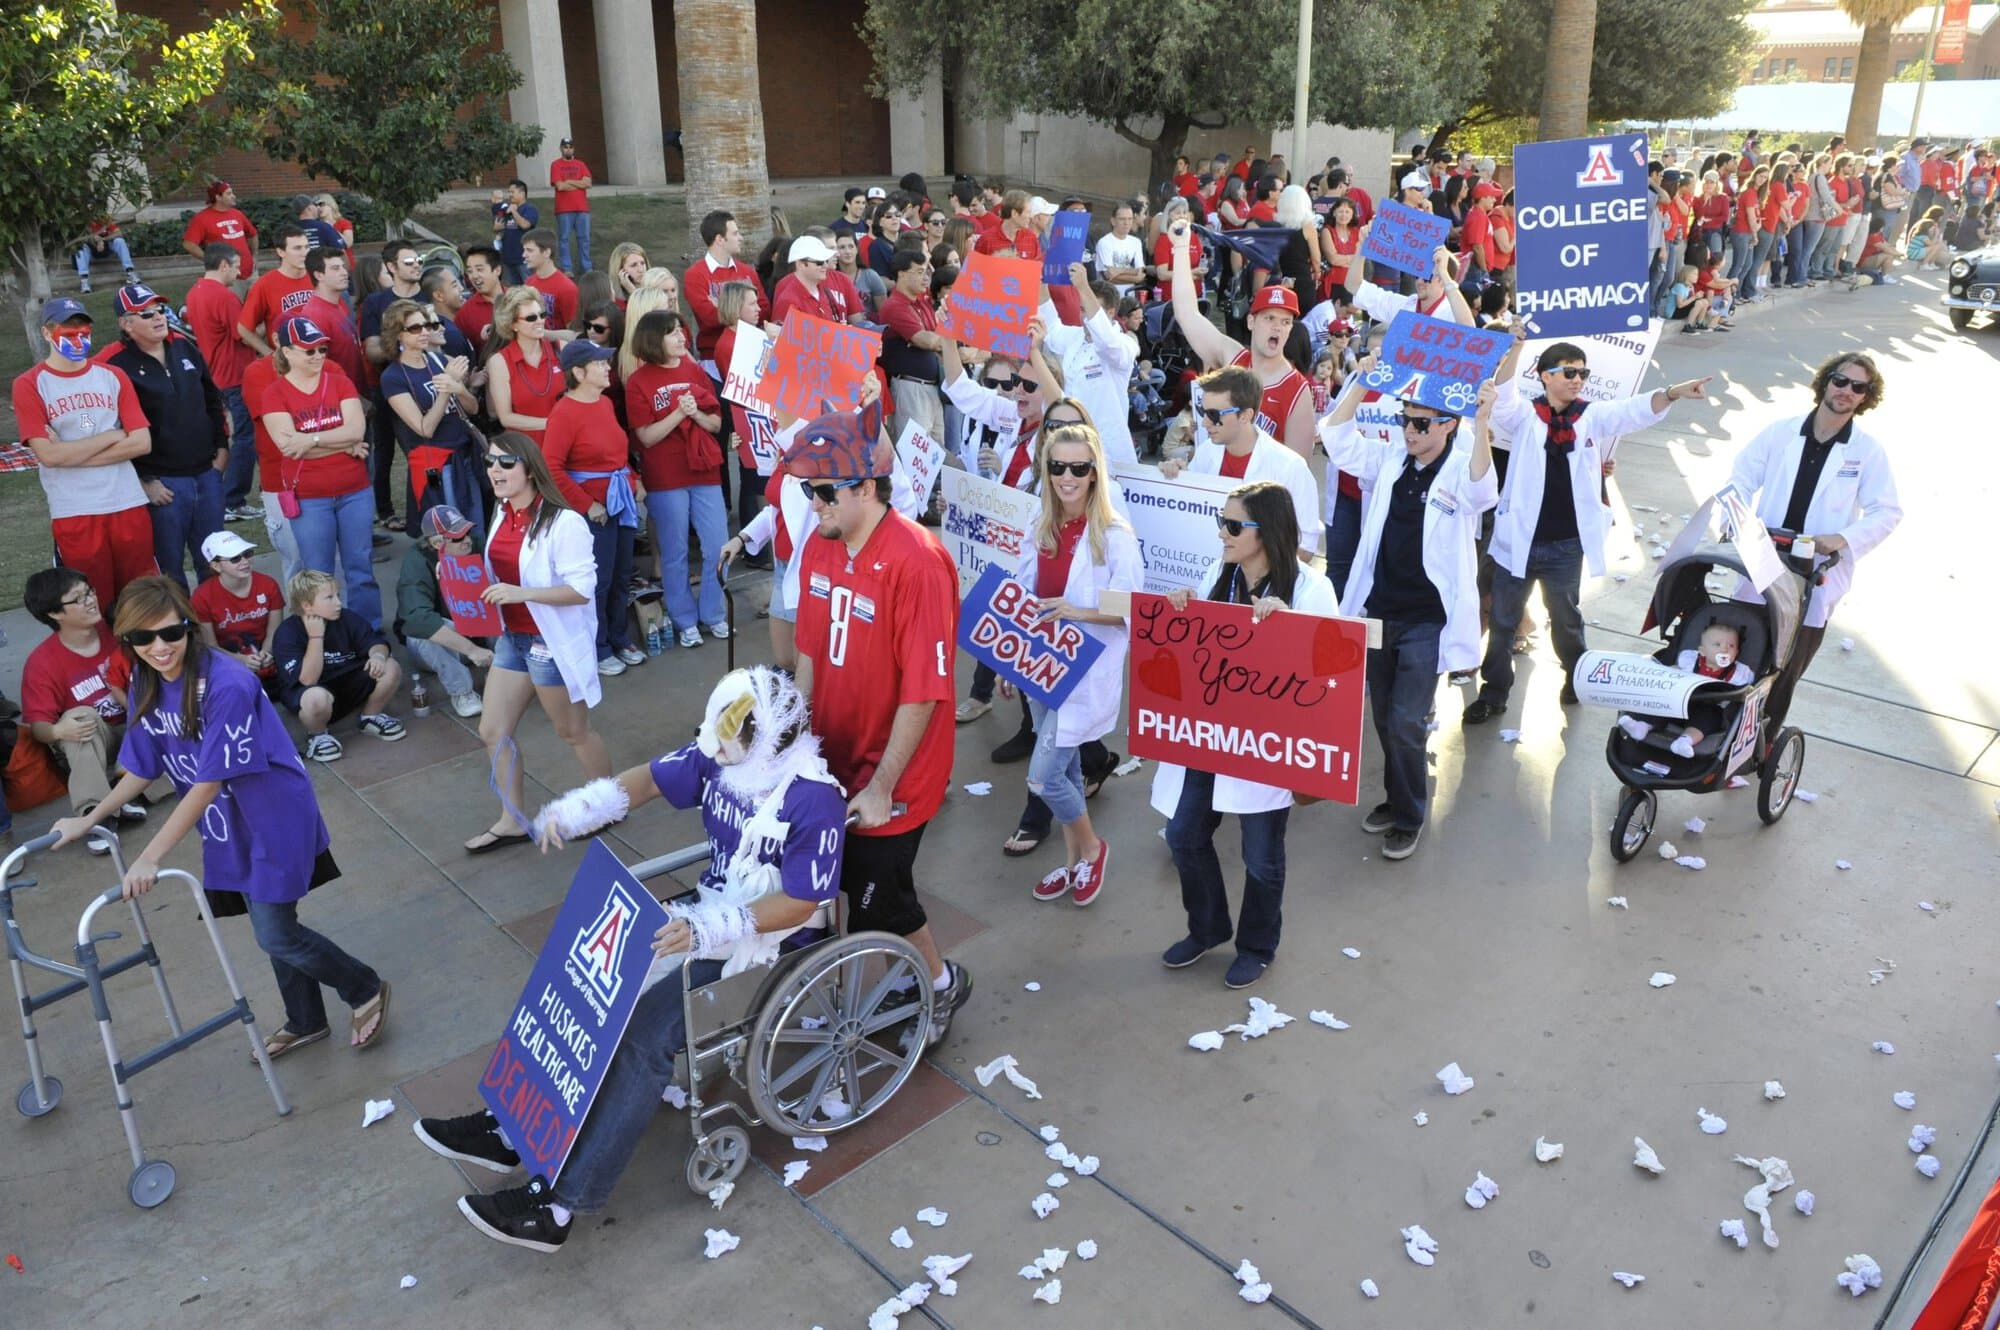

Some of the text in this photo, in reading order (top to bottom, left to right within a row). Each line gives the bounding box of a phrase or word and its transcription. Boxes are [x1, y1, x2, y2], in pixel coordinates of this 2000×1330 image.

[1576, 143, 1624, 188] A
[1518, 198, 1647, 230] COLLEGE
[1560, 243, 1600, 267] OF
[281, 289, 316, 313] ARIZO
[952, 291, 1029, 325] PHARMACY
[1516, 281, 1650, 313] PHARMACY
[784, 313, 878, 371] ILDCATS
[1410, 322, 1496, 355] LET'S GO
[796, 354, 832, 397] FOR
[1395, 346, 1484, 383] WILDCATS
[1393, 372, 1427, 401] A
[47, 392, 115, 421] ARIZONA
[1123, 488, 1223, 517] Homecomin
[1150, 545, 1199, 565] COLLEGE
[830, 585, 852, 668] 8
[988, 577, 1084, 661] BEAR
[1136, 599, 1253, 650] Love
[969, 612, 1069, 693] DOWN
[1193, 647, 1327, 706] Your
[1588, 658, 1616, 685] A
[1615, 675, 1677, 691] PHARMACY
[1617, 663, 1665, 678] COLLEGE
[224, 714, 252, 740] W
[223, 738, 252, 769] 15
[1138, 709, 1350, 780] PHARMACIST!
[818, 827, 838, 855] 10
[811, 859, 836, 891] W
[539, 983, 597, 1071] HUSKIES
[513, 1005, 586, 1116] HEALTHCARE
[483, 1037, 577, 1177] DENIED!
